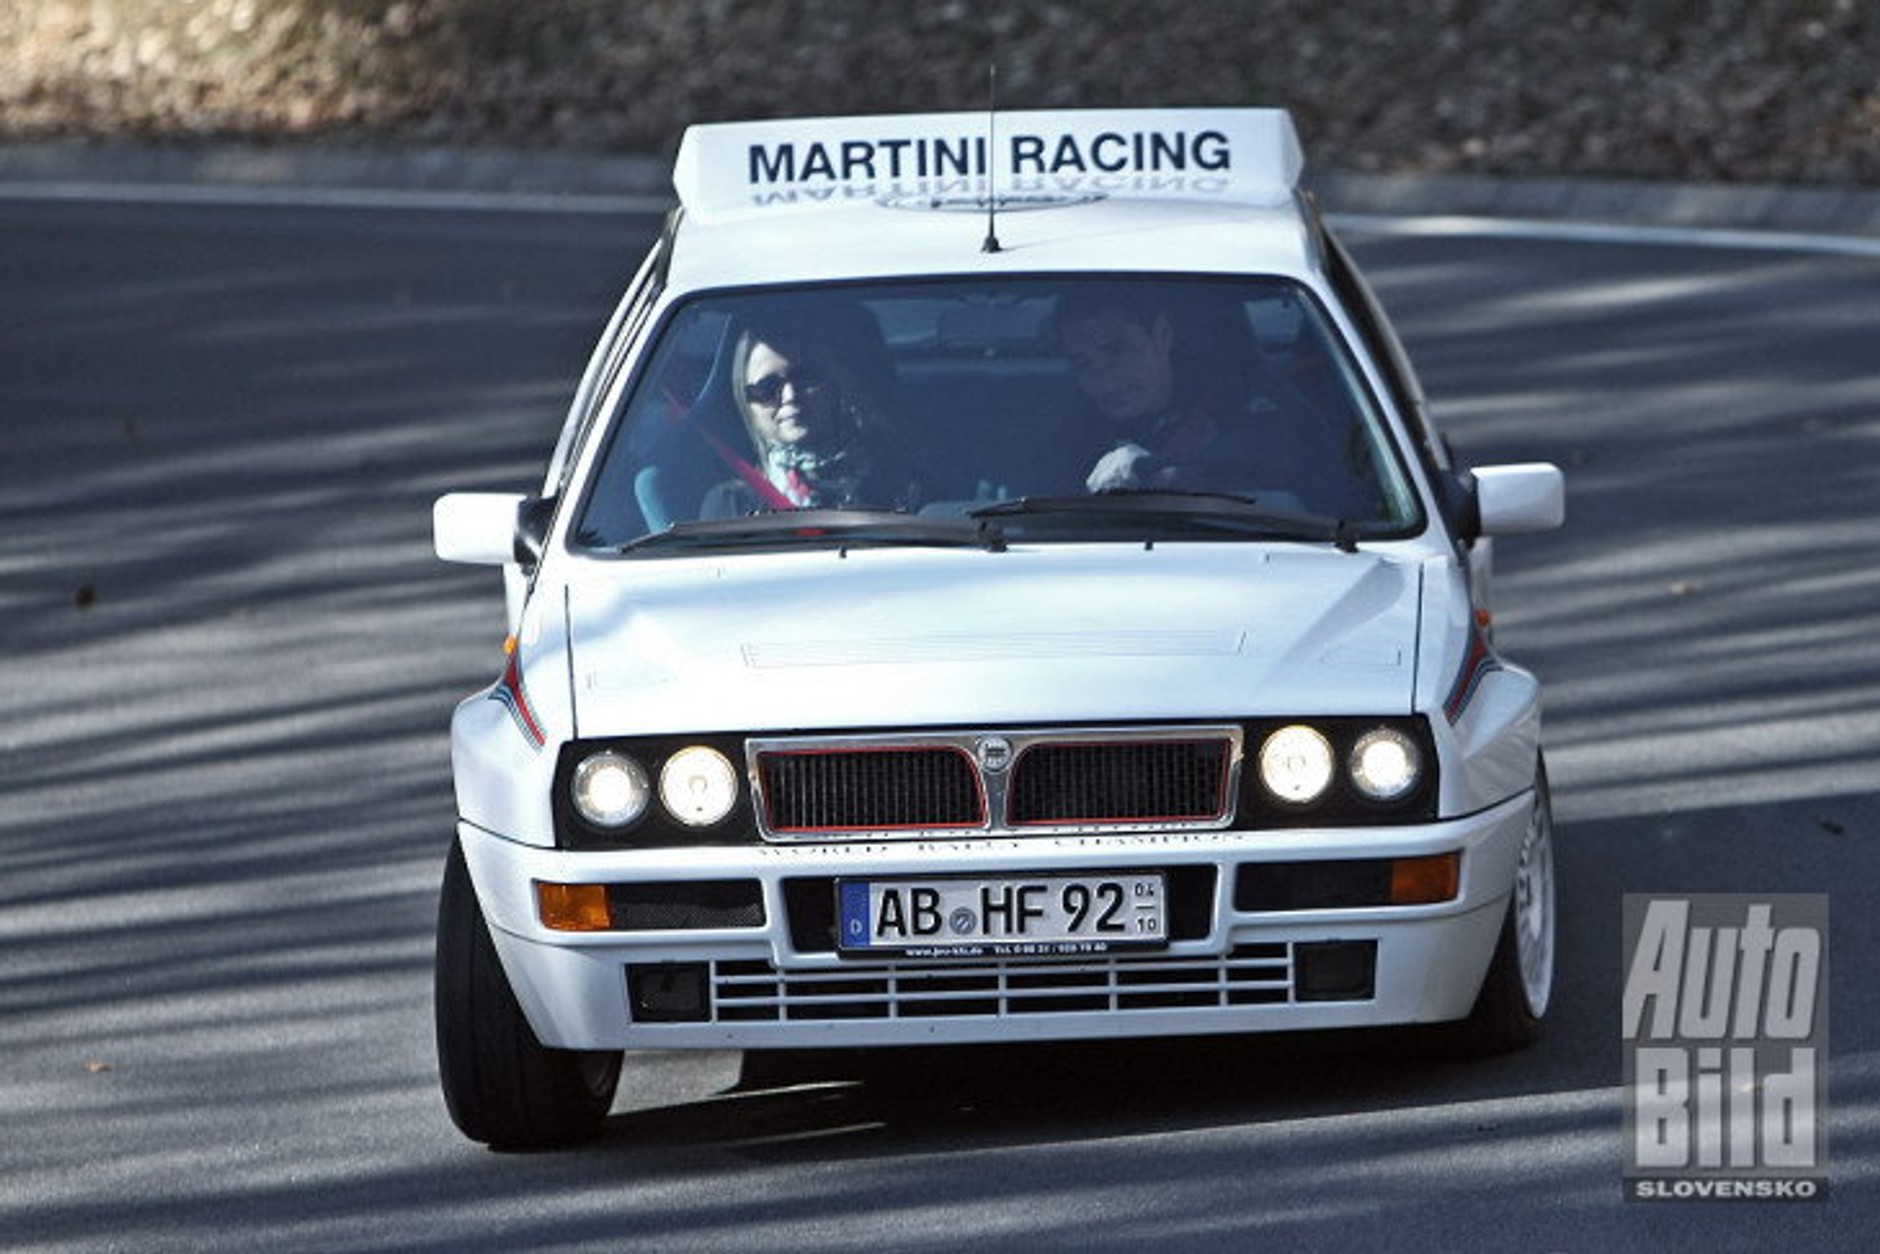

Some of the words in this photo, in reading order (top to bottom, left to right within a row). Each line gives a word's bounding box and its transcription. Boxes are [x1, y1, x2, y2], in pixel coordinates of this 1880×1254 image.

[748, 137, 987, 184] MARTINI
[1011, 131, 1232, 174] RACING
[876, 887, 943, 937] AB
[980, 885, 1048, 935] HF
[1062, 882, 1126, 933] 92
[1137, 918, 1156, 932] 10
